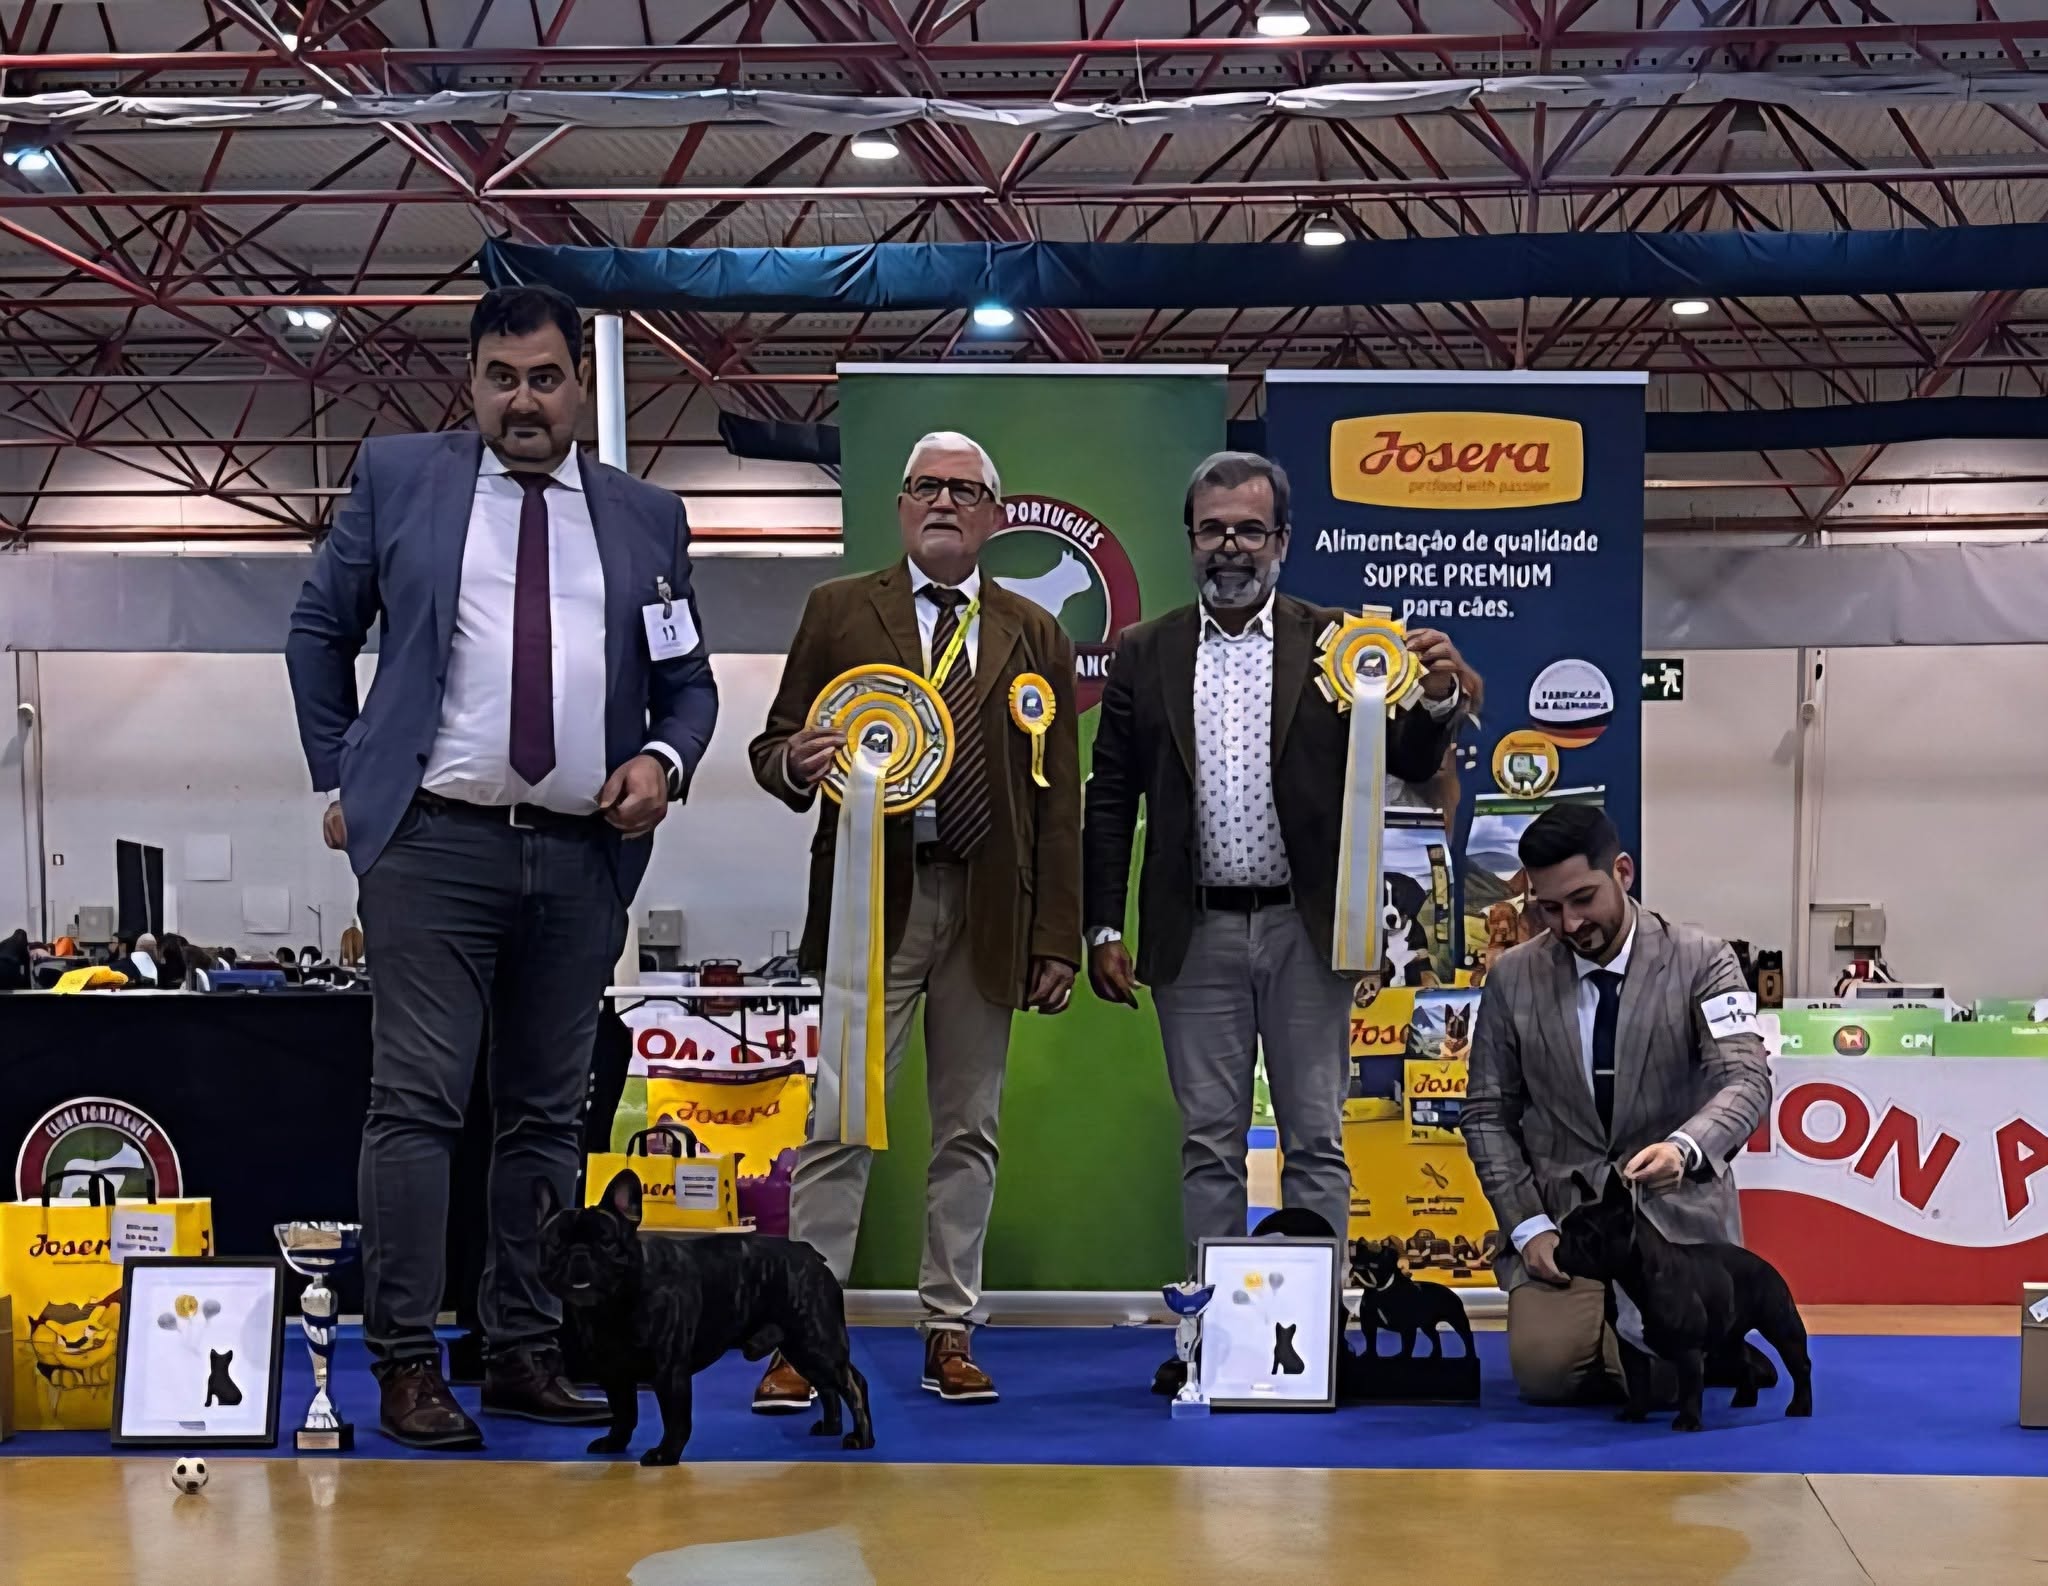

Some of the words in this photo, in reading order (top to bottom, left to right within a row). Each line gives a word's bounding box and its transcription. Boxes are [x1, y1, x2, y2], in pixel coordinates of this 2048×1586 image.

[1359, 431, 1550, 475] Josera
[1315, 528, 1457, 557] Alimentação
[1462, 529, 1488, 552] de
[1494, 529, 1599, 558] qualidade
[1363, 563, 1438, 588] SUPRE
[1444, 563, 1552, 588] PREMIUM
[1403, 599, 1453, 623] para
[677, 1101, 781, 1125] Josera
[29, 1234, 112, 1257] Joser
